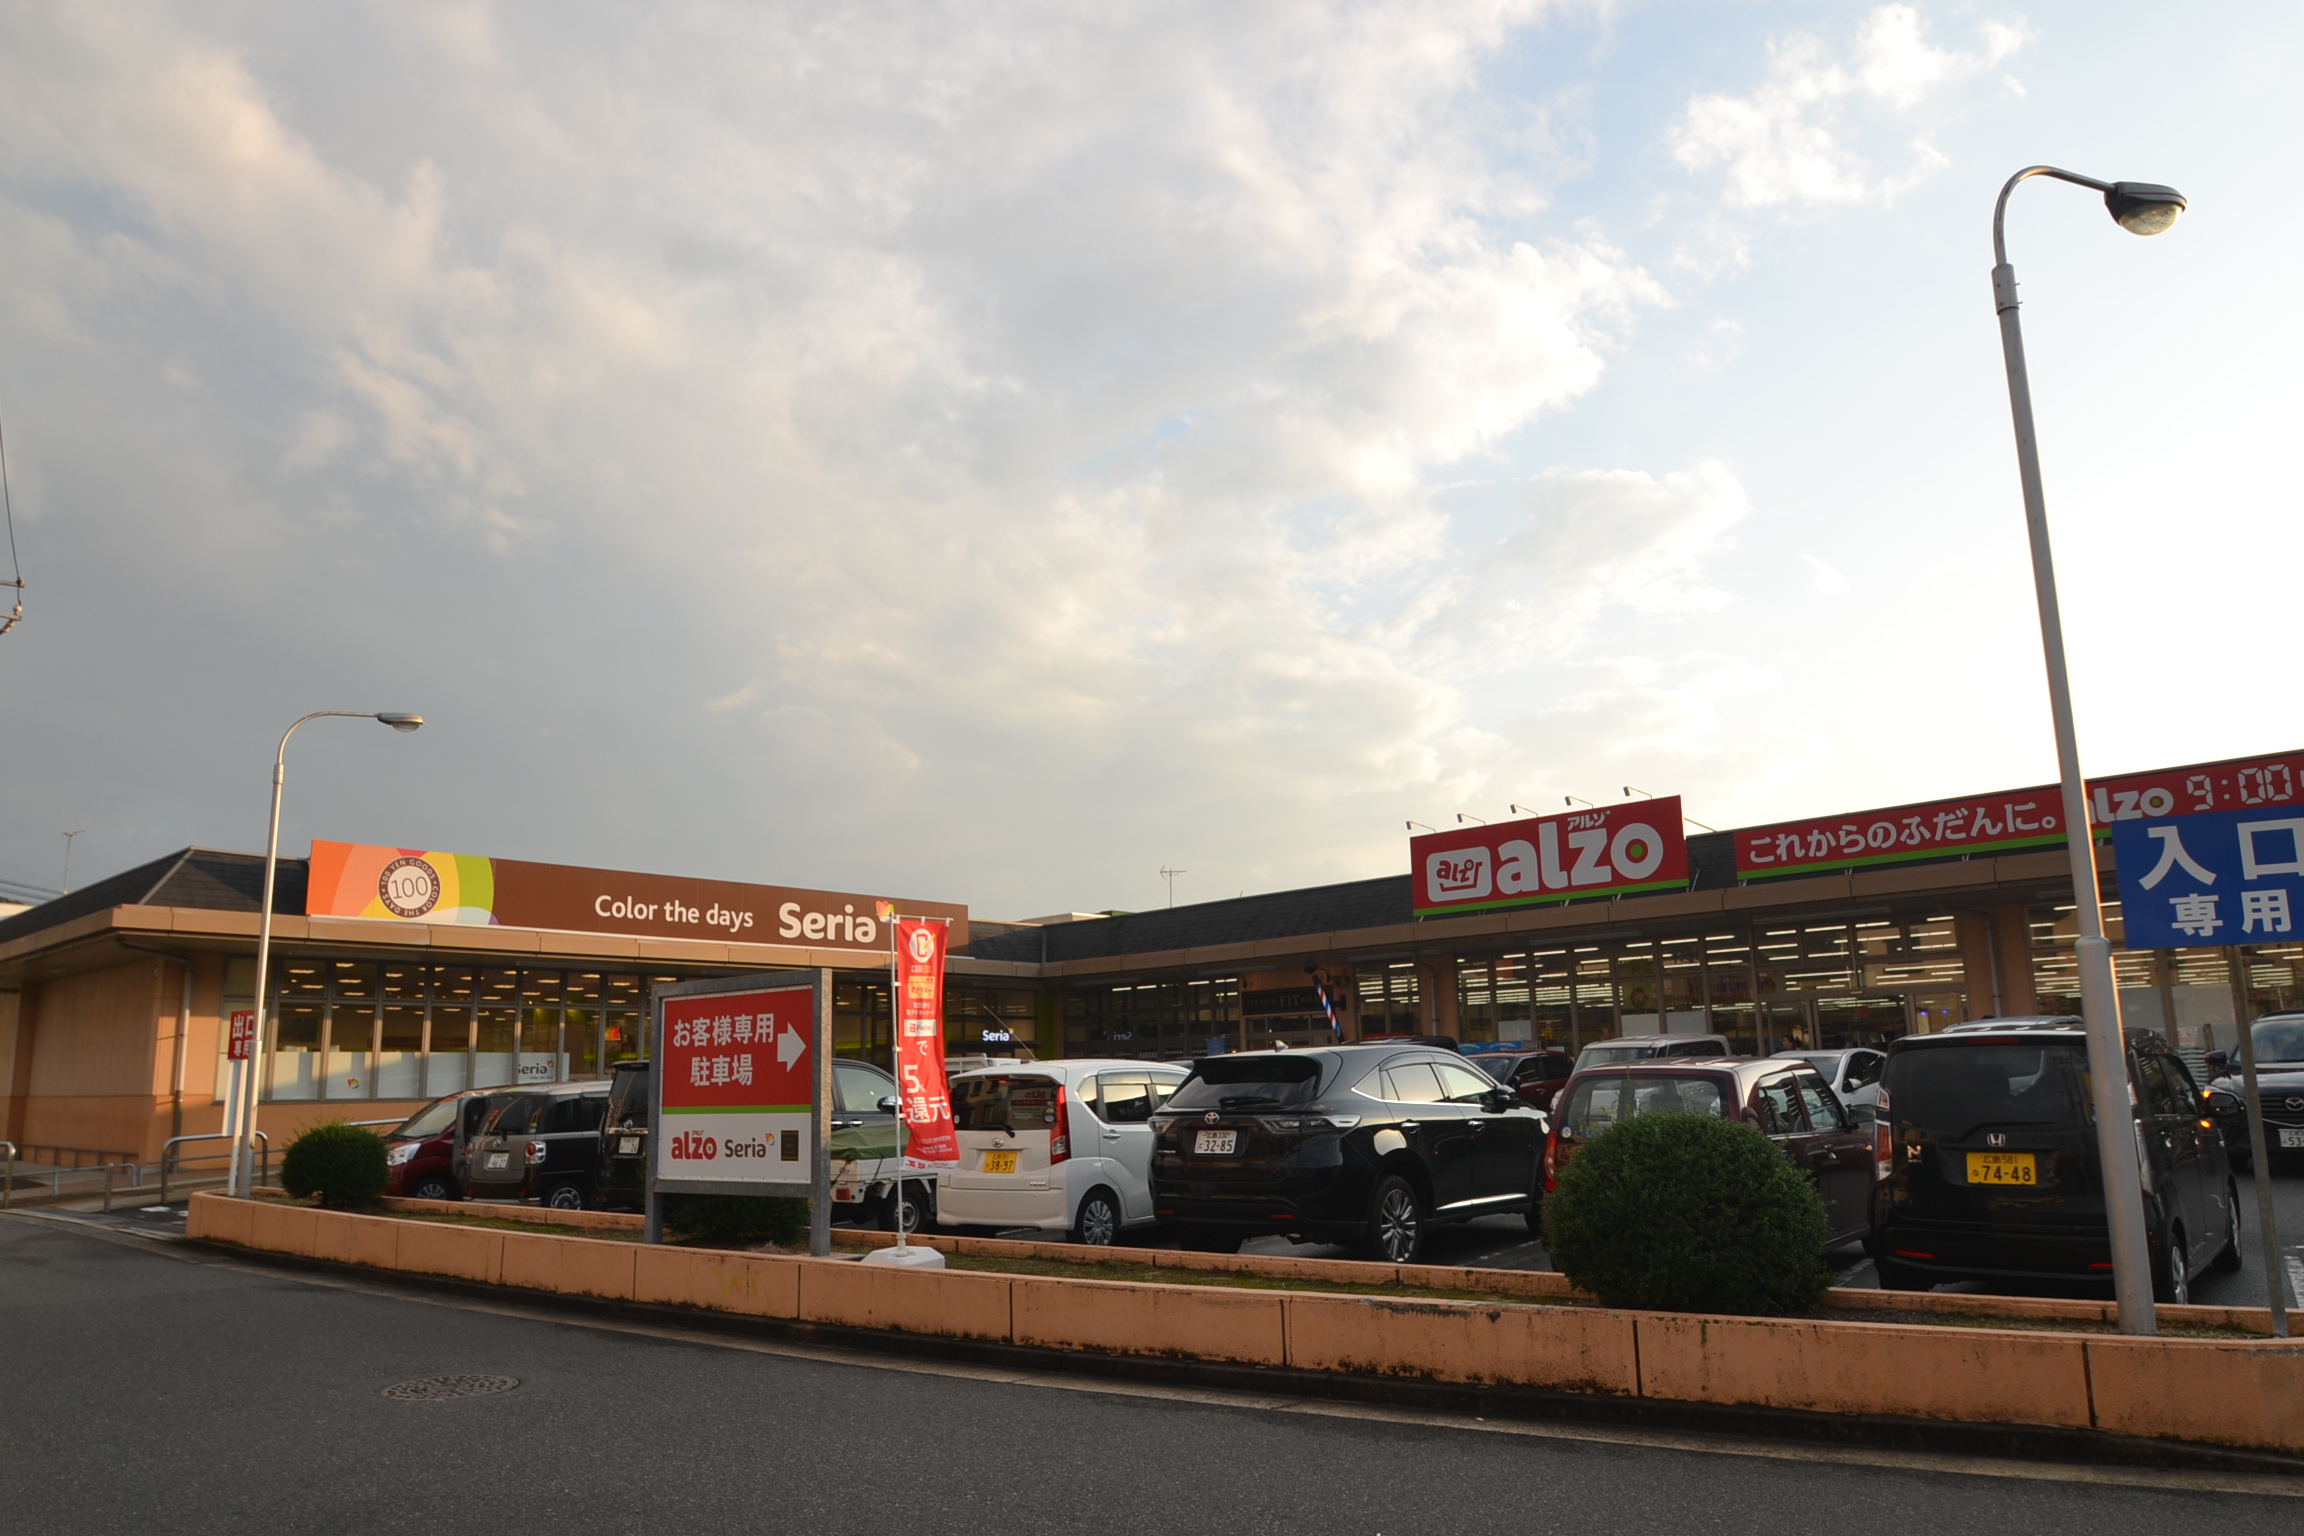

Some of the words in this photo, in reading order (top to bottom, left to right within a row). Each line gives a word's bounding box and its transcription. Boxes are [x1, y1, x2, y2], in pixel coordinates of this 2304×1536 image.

[1567, 810, 1611, 831] アルゾ
[1749, 801, 2057, 864] これからのふだんに。
[1496, 821, 1664, 895] alzo
[2138, 817, 2304, 891] 入口
[390, 859, 406, 871] YEN
[409, 859, 436, 880] GOODS
[391, 876, 429, 900] 100
[594, 895, 657, 920] Color
[664, 899, 700, 925] the
[706, 903, 754, 933] days
[778, 902, 877, 943] Seria
[2168, 888, 2292, 937] 専用
[673, 1013, 774, 1047] お客様専用
[982, 1029, 1010, 1042] Seria
[916, 1040, 928, 1056] で
[690, 1053, 753, 1087] 駐車場
[906, 1095, 951, 1124] 還元
[671, 1131, 717, 1160] alzo
[724, 1137, 767, 1158] Seria
[1204, 1140, 1234, 1152] 32-85
[989, 1160, 1014, 1171] 38-97
[1982, 1165, 2032, 1182] 74-48
